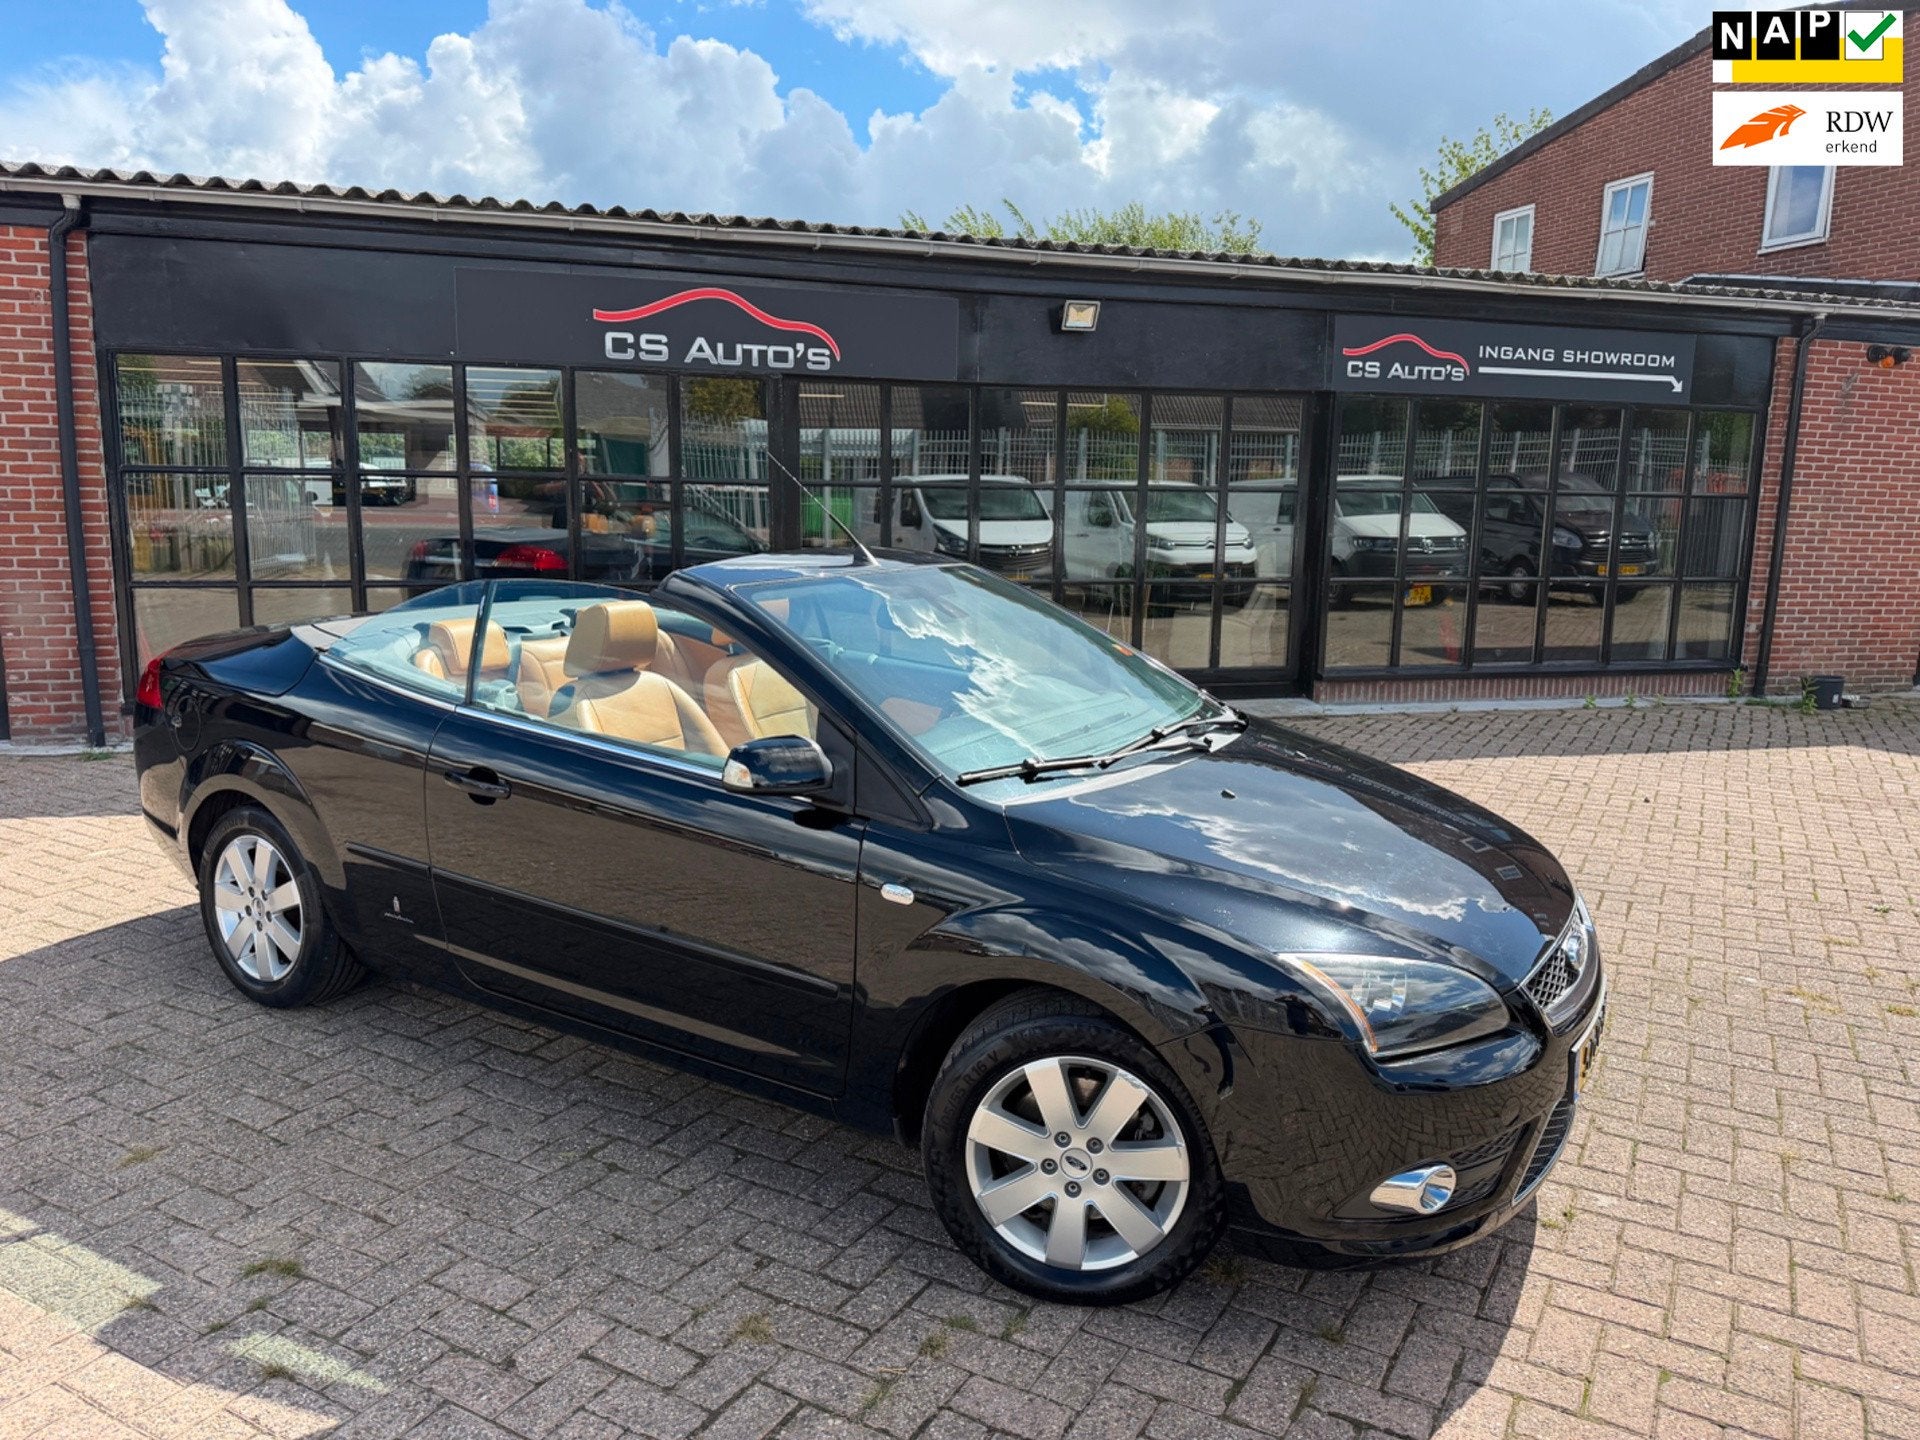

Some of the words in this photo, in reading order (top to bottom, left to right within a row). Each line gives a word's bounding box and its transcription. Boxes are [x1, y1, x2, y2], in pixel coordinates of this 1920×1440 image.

[604, 332, 669, 362] CS
[1478, 344, 1555, 363] INGANG
[1562, 349, 1676, 368] SHOWROOM
[1346, 360, 1381, 379] CS
